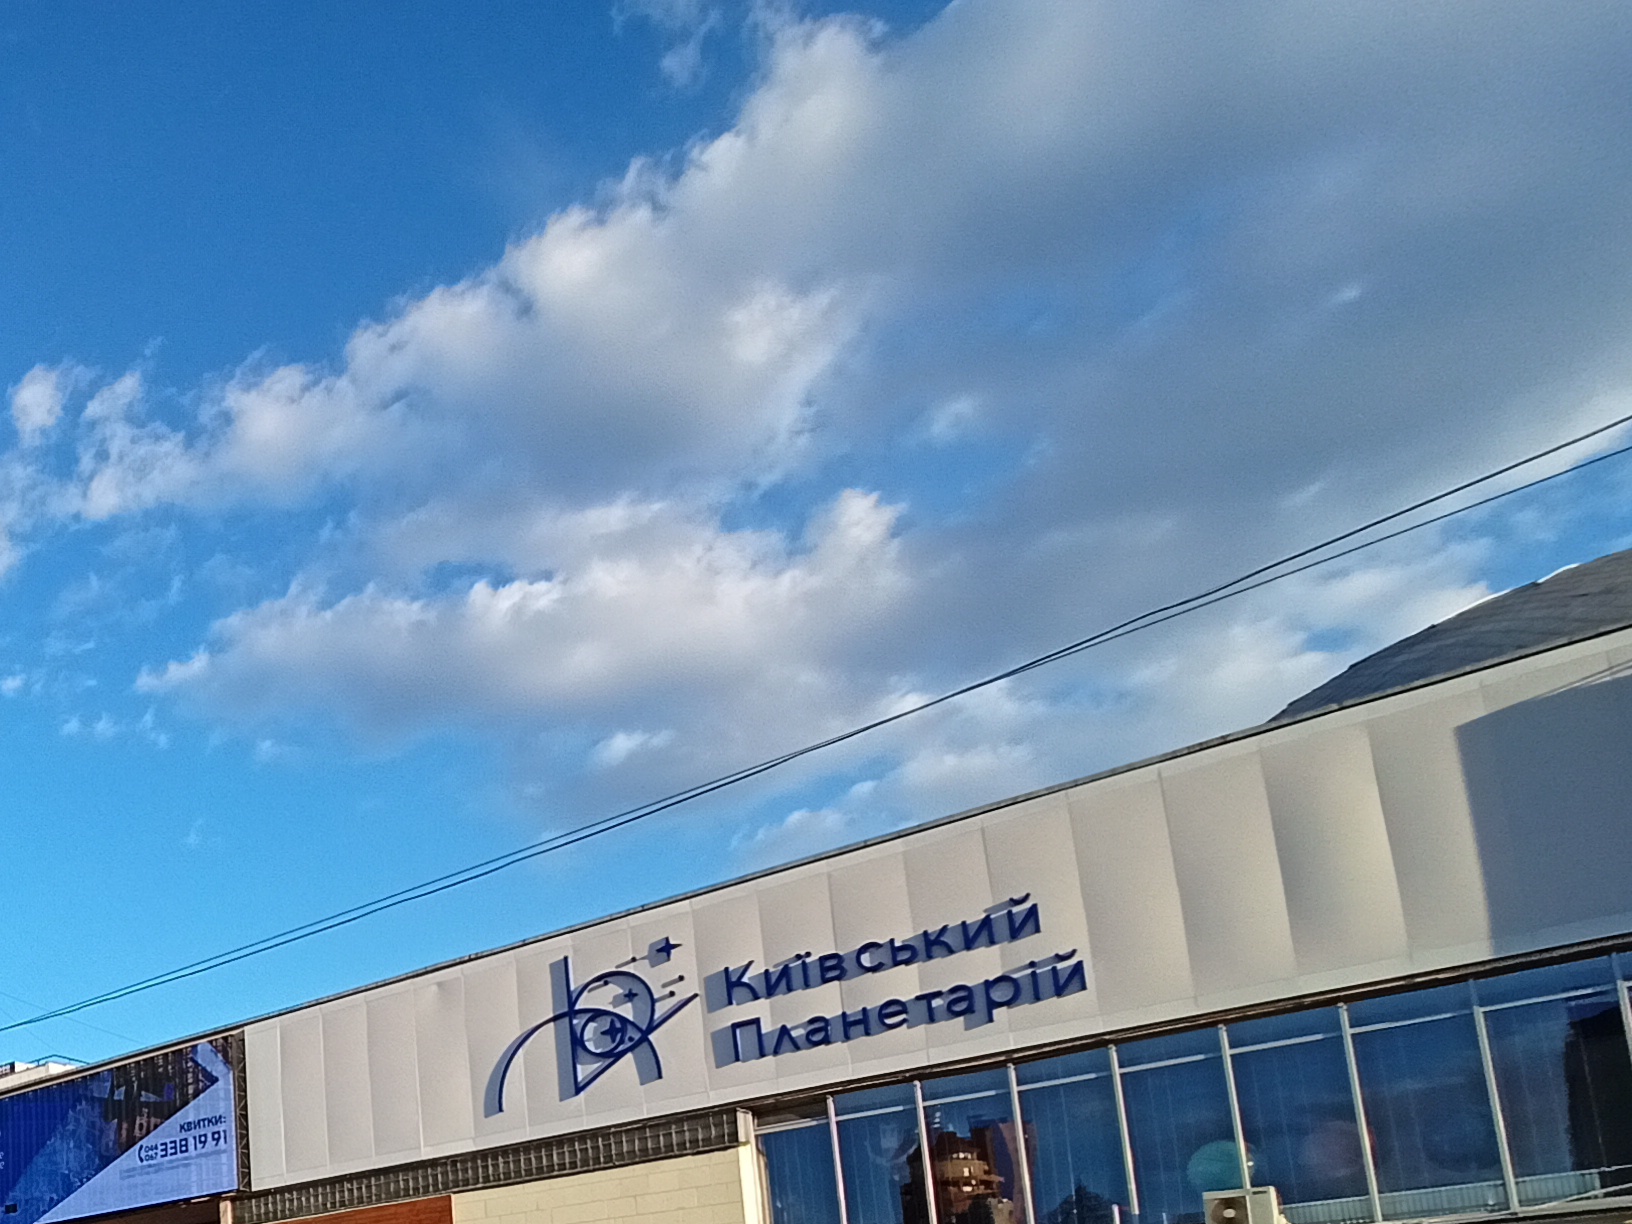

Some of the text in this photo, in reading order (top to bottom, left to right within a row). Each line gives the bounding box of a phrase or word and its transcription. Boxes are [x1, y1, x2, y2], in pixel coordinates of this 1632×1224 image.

[723, 892, 1042, 1006] Київський
[730, 929, 1088, 1063] Планетарій
[159, 1137, 189, 1158] 338
[192, 1133, 208, 1151] 19
[211, 1129, 228, 1147] 91
[179, 1114, 227, 1134] КВИТКИ:
